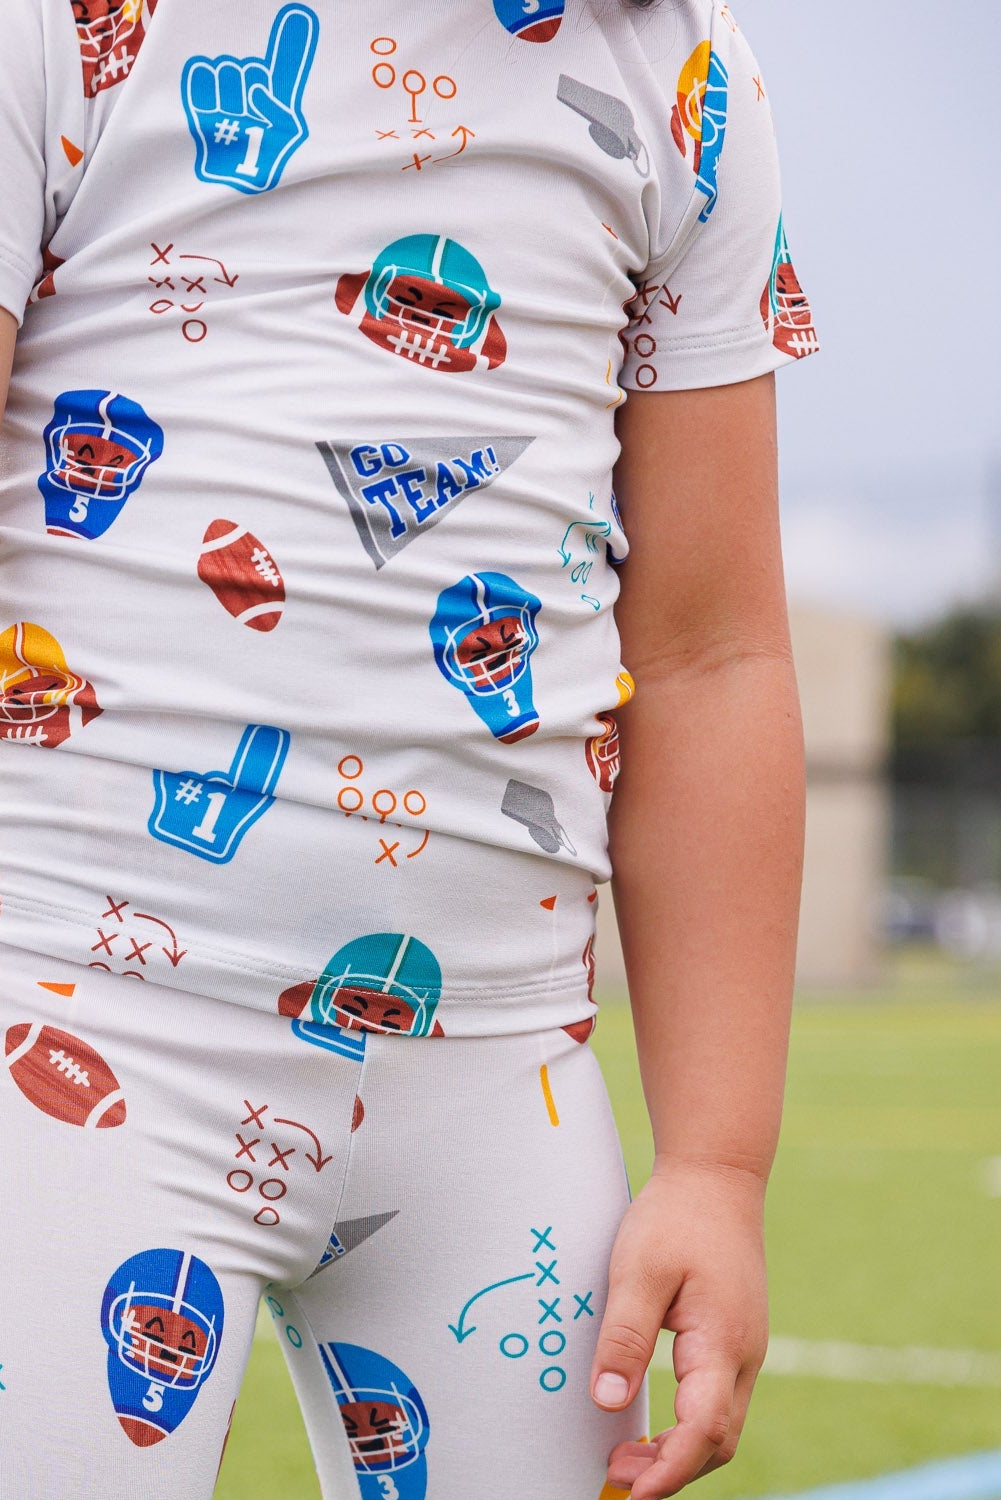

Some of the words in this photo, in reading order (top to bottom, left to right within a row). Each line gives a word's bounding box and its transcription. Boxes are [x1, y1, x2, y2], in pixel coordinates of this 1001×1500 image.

[213, 118, 265, 178] #1
[350, 441, 413, 479] GO
[68, 494, 90, 523] 5
[360, 445, 501, 540] TEAM!
[502, 688, 521, 718] 3
[174, 778, 227, 844] #1
[142, 1381, 166, 1413] 5
